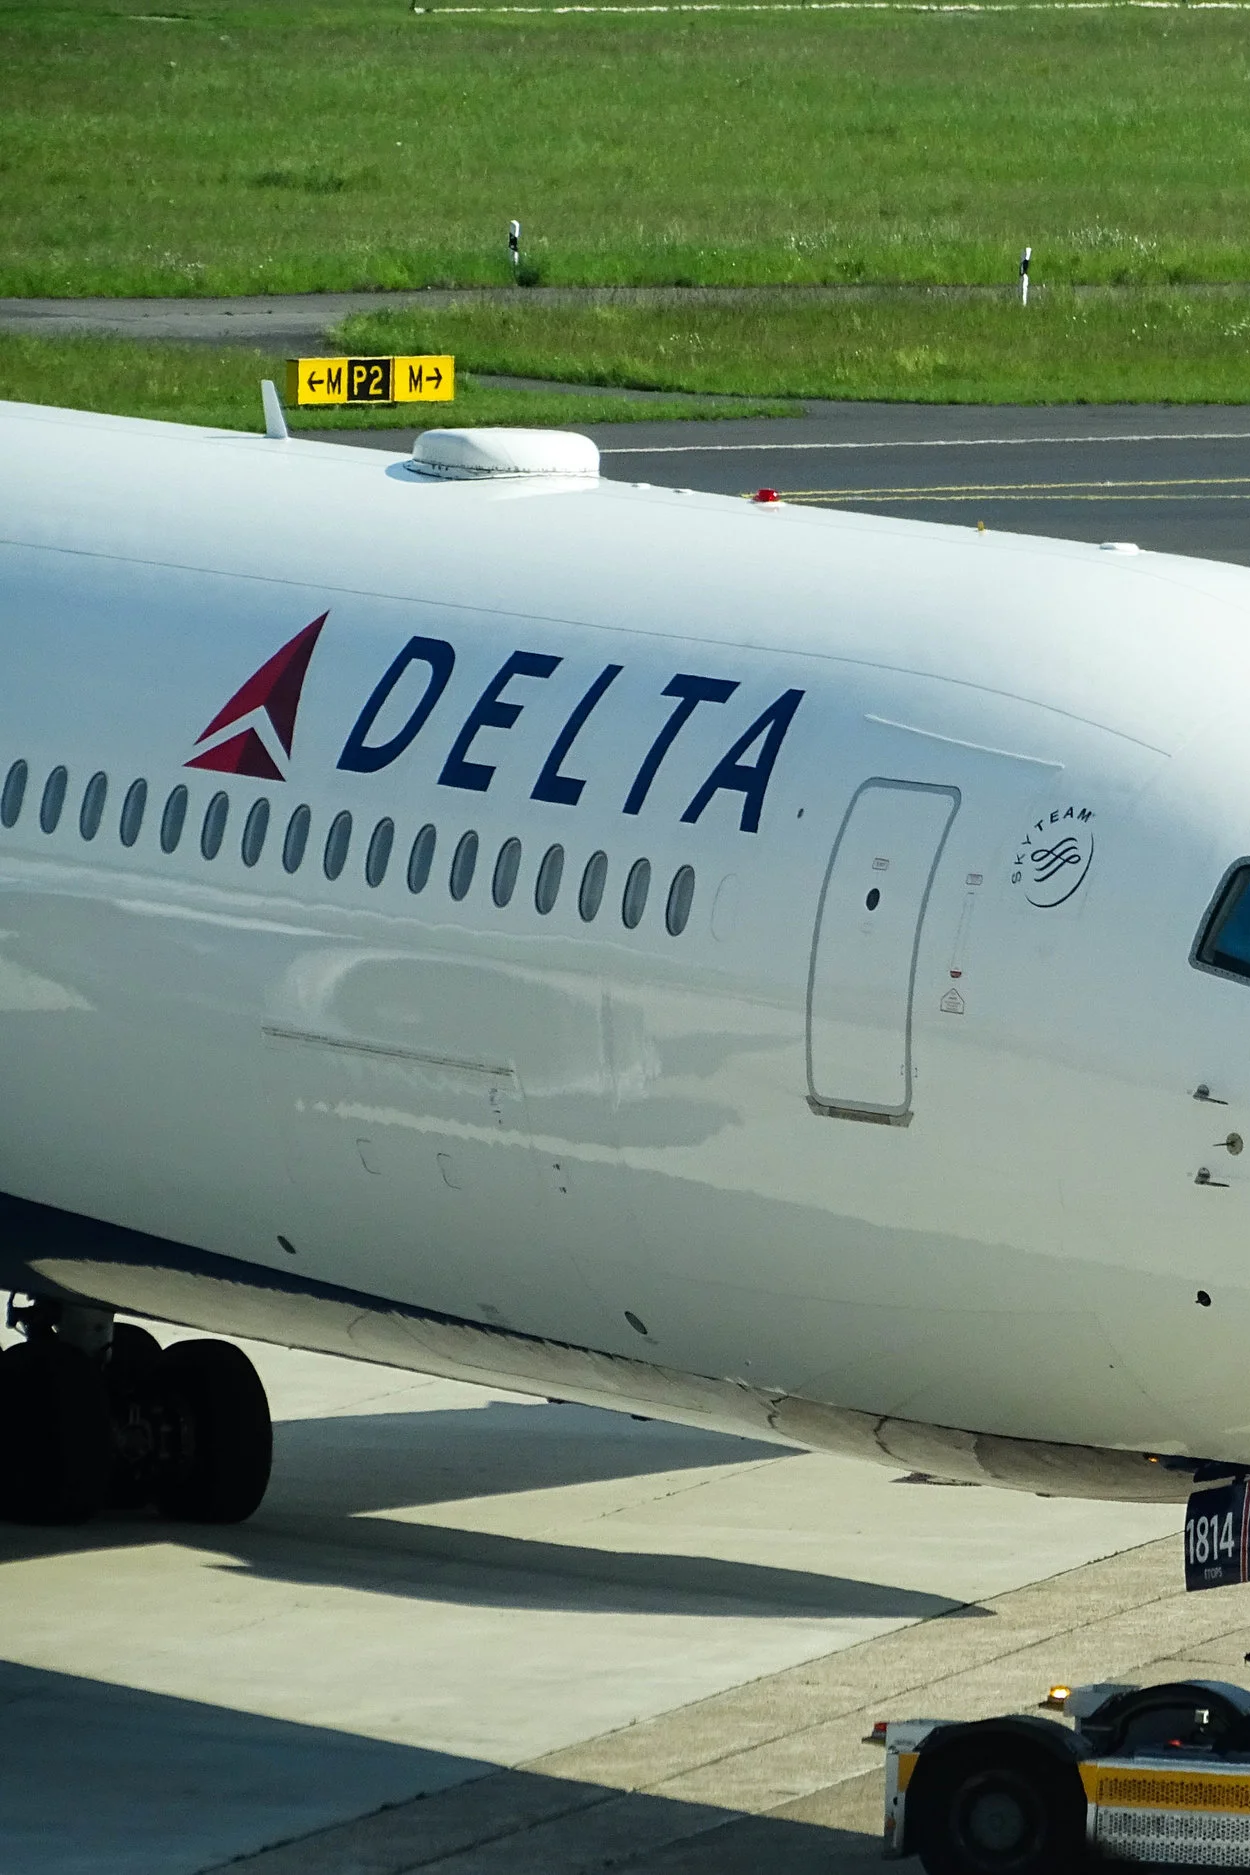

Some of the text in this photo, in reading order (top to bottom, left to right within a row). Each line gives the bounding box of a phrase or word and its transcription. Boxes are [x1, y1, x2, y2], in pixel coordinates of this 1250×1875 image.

[327, 364, 423, 396] M P2 M
[336, 635, 806, 833] DELTA
[1186, 1512, 1234, 1565] 1814
